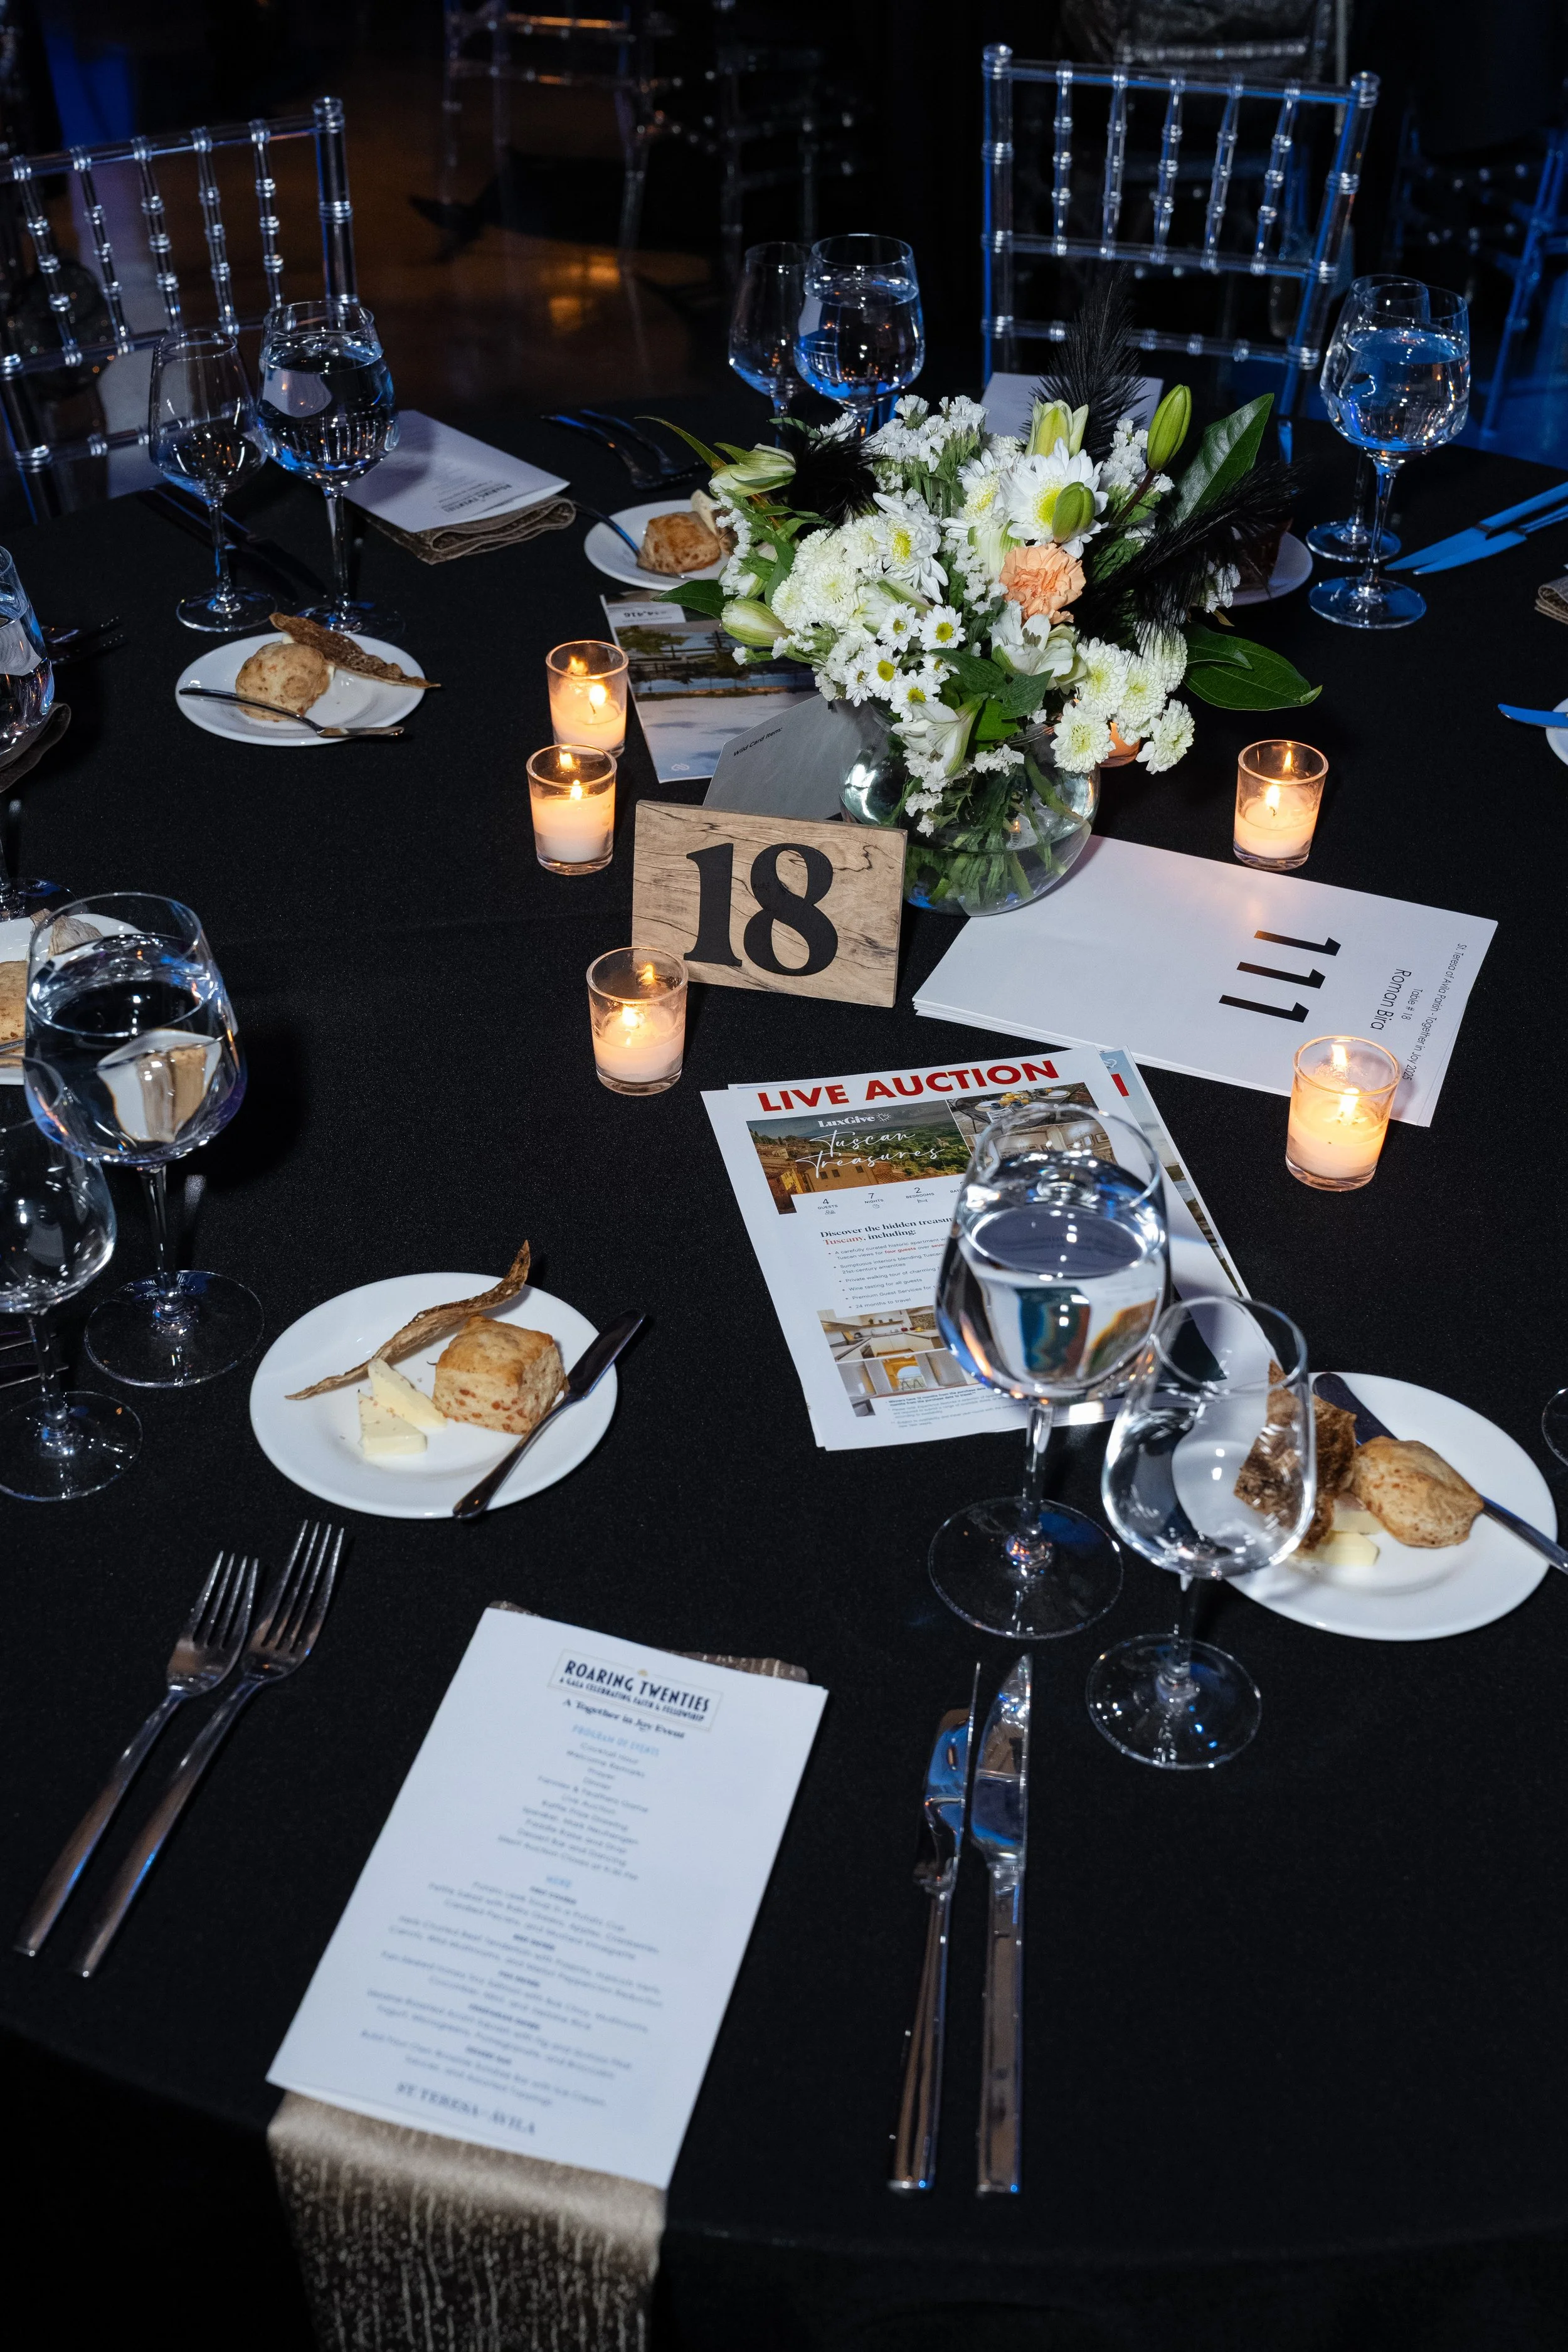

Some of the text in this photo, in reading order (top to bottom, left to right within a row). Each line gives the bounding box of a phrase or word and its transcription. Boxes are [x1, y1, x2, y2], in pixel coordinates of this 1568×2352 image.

[733, 728, 783, 756] Wild Card Item:
[684, 842, 839, 977] 18
[1447, 951, 1465, 970] Teresa
[1218, 930, 1342, 1024] 111
[1438, 978, 1453, 993] Avila
[1444, 971, 1454, 979] of
[1370, 968, 1412, 1031] Roman Bira
[1407, 988, 1423, 1004] Table
[1430, 993, 1446, 1012] Parish
[1401, 1012, 1412, 1021] 18
[1416, 1016, 1438, 1046] Together
[1407, 1051, 1421, 1064] Joy
[1402, 1064, 1417, 1081] 2025
[757, 1060, 1060, 1112] LIVE AUCTION
[817, 1114, 876, 1128] LuxGive
[809, 1129, 916, 1158] Tuscan
[795, 1145, 945, 1180] Treasures
[820, 1229, 862, 1237] Discover
[867, 1230, 916, 1239] including:
[564, 1660, 710, 1712] ROARING TWENTIES
[563, 1698, 685, 1739] A Together in Joy Event
[572, 1725, 659, 1756] PROGRAM OF EVENTS
